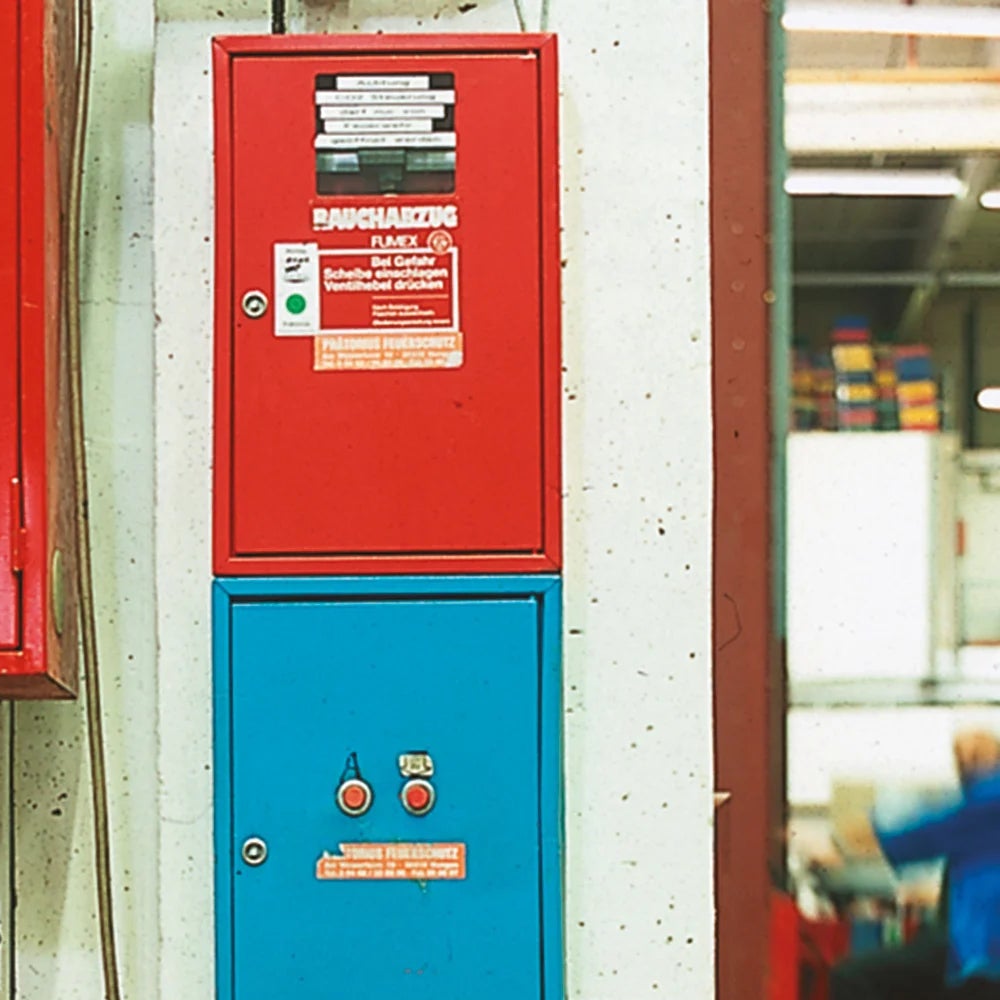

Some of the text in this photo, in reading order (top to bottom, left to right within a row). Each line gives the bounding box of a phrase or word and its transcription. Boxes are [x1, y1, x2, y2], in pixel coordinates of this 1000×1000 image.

[312, 205, 458, 231] RAUCHABZUG
[371, 235, 418, 248] FUMEX
[371, 255, 436, 268] Bei Gefahr
[323, 267, 449, 281] Scheibe einschlagen
[323, 279, 444, 292] Ventilhebel drücken
